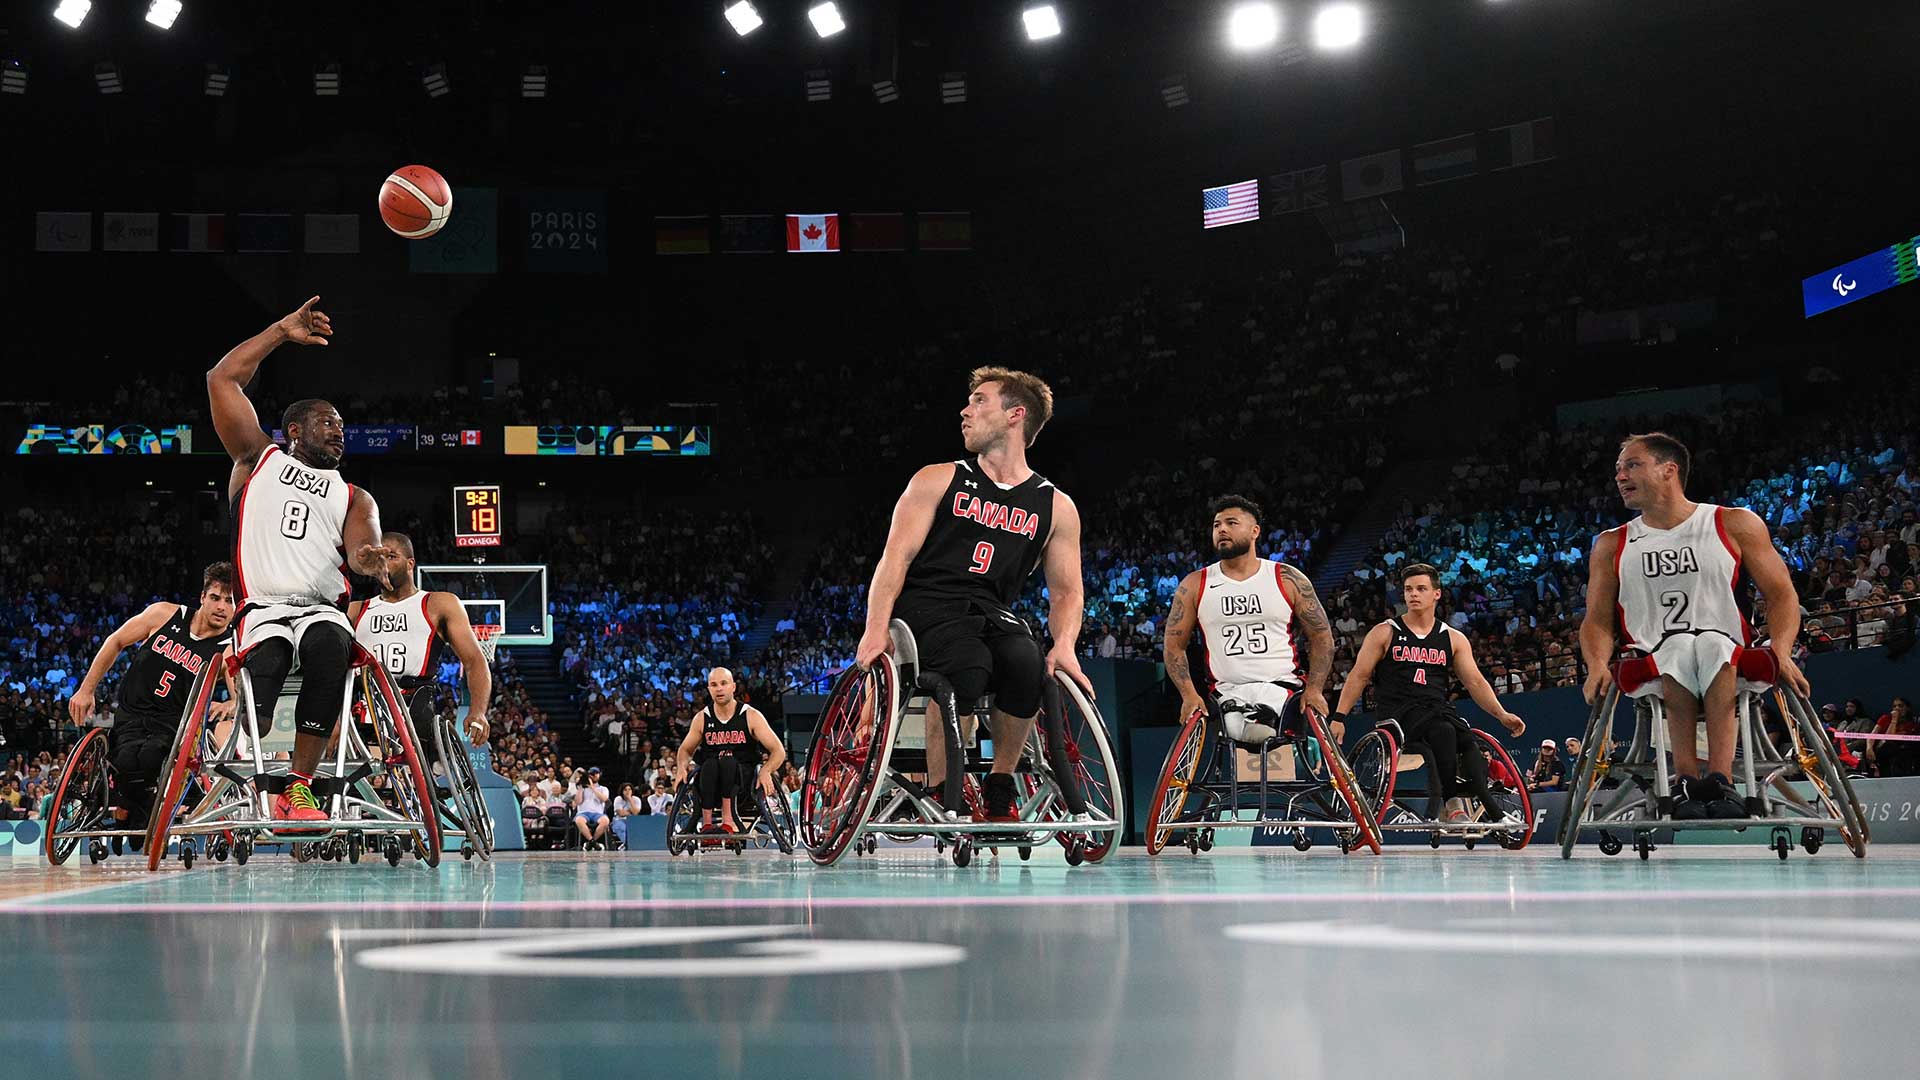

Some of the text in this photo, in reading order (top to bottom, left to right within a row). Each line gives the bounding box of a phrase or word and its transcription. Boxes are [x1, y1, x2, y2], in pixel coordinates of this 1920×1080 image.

[530, 211, 597, 230] PARIS
[531, 231, 598, 251] 2024
[368, 437, 389, 447] 9:22
[420, 434, 435, 446] 39
[441, 433, 459, 441] CAN
[279, 464, 331, 499] USA
[465, 491, 497, 506] 9:21
[280, 500, 310, 541] 8
[471, 508, 496, 533] 18
[953, 491, 1039, 540] CANADA
[468, 537, 498, 545] OMEGA
[968, 540, 995, 574] 9
[1641, 546, 1699, 578] USA
[1221, 594, 1262, 616] USA
[1660, 590, 1691, 632] 2
[370, 613, 408, 634] USA
[1221, 622, 1268, 656] 25
[151, 634, 203, 675] CANAD
[373, 642, 407, 675] 16
[1392, 645, 1447, 667] CANADA
[154, 670, 176, 698] 5
[1413, 668, 1427, 685] 4
[705, 730, 747, 746] CANADA
[469, 752, 486, 761] RIS
[1859, 802, 1892, 822] RIS
